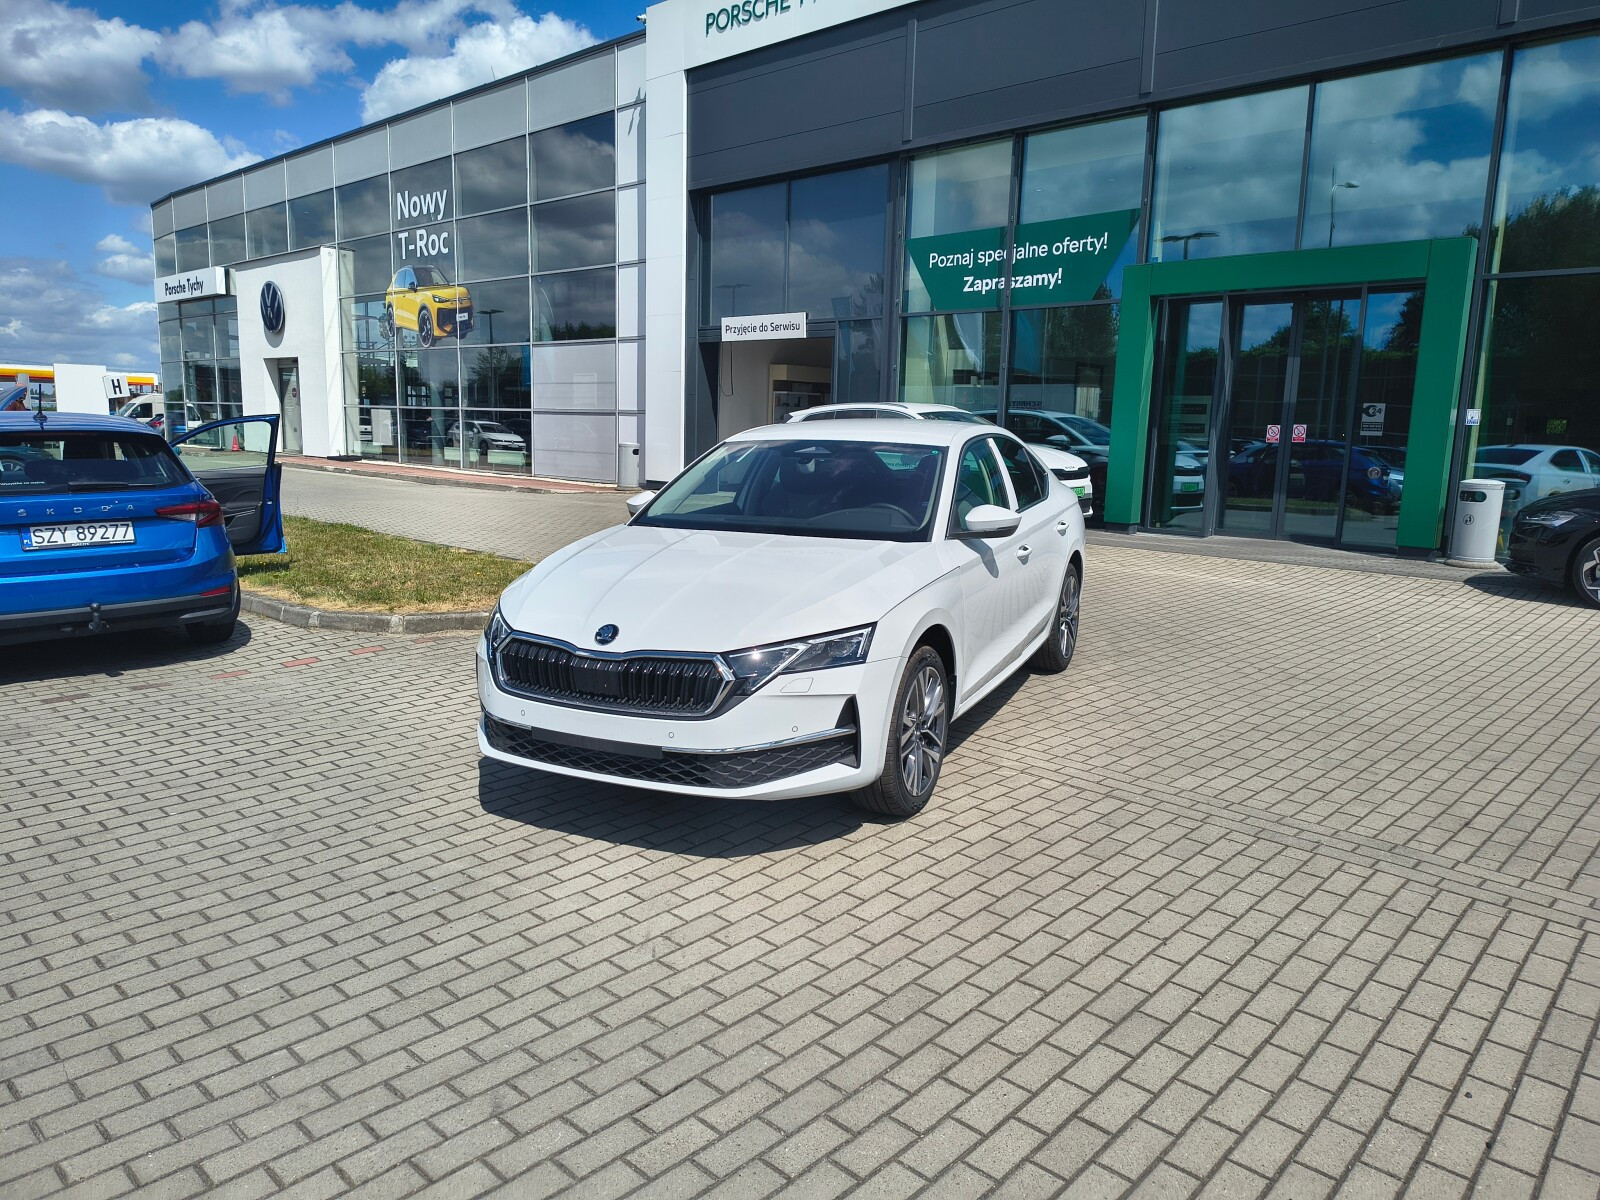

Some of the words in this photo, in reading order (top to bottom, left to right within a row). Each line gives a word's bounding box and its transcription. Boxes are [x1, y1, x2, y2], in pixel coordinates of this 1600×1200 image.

[705, 0, 791, 35] PORSCHE
[396, 189, 448, 221] Nowy
[398, 228, 449, 260] T-Roc
[929, 248, 974, 269] Poznaj
[1052, 232, 1108, 256] oferty!
[164, 279, 187, 296] Porsche
[186, 275, 204, 296] Tychy
[963, 267, 1063, 294] Zapraszamy!
[725, 323, 758, 336] Przyjęcie
[758, 322, 769, 333] do
[769, 320, 801, 332] Serwisu
[110, 378, 123, 395] H
[32, 526, 69, 545] SZY
[75, 523, 130, 541] 89277
